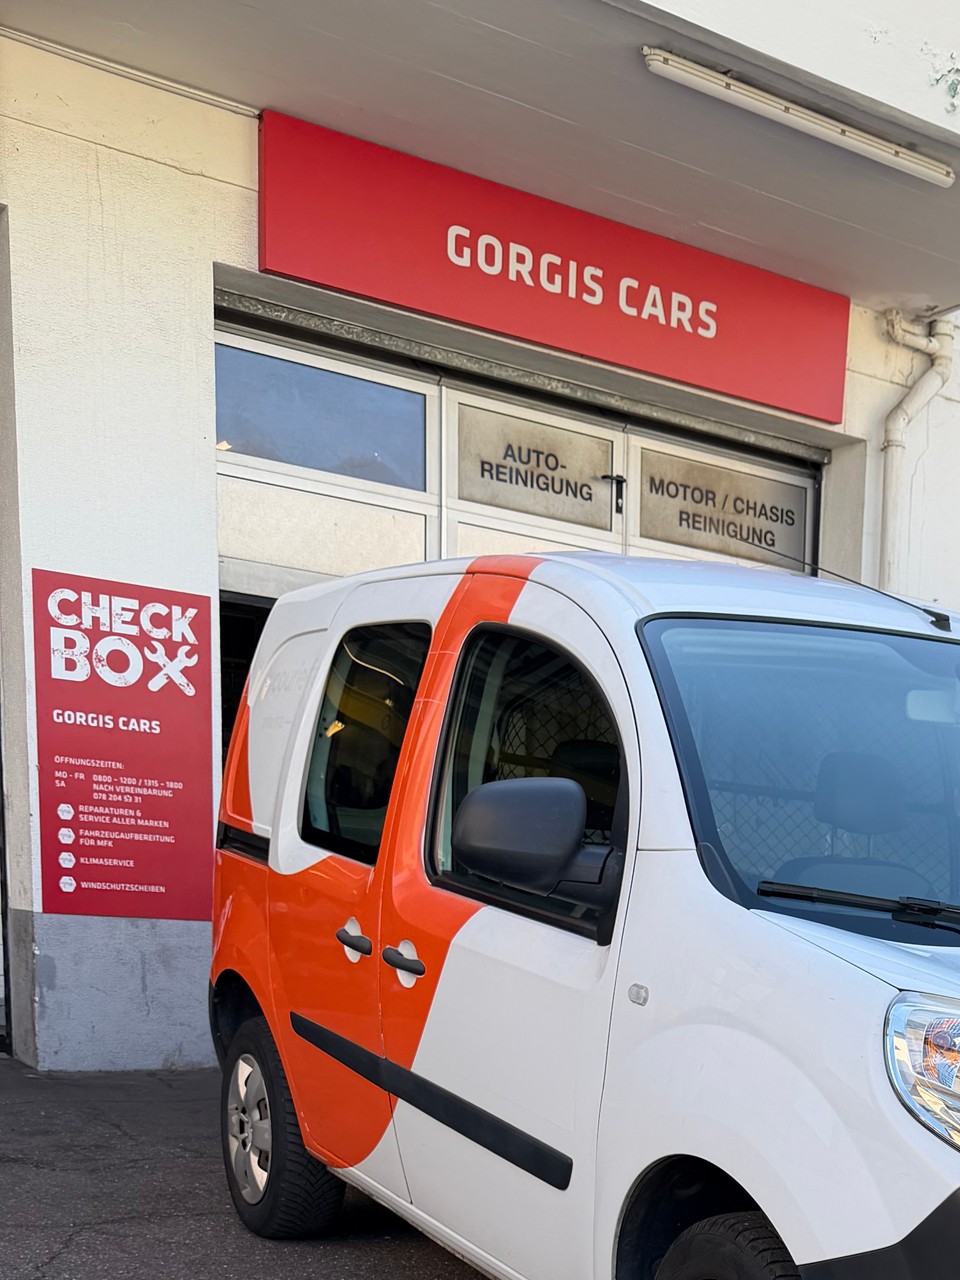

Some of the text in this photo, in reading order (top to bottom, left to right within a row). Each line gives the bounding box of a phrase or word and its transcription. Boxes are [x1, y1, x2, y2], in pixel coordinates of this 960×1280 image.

[447, 224, 718, 339] GORGIS CARS
[502, 443, 567, 473] AUTO-
[480, 460, 593, 503] REINIGUNG
[649, 476, 796, 527] MOTOR / CHASIS
[678, 510, 776, 549] REINIGUNG
[48, 588, 198, 644] CHECK
[53, 709, 160, 733] GORGIS CARS
[54, 755, 125, 769] ÖFFNUNGSZEITEN:
[55, 770, 67, 778] MO
[75, 772, 85, 780] FR
[93, 774, 112, 782] 0800
[120, 776, 137, 785] 1200
[166, 781, 183, 790] 1800
[93, 783, 114, 792] NACH
[116, 786, 173, 797] VEREINBARUNG
[93, 792, 107, 800] 078
[79, 804, 135, 816] REPARATUREN
[79, 814, 170, 829] SERVICE ALLER MARKEN
[79, 829, 176, 844] FAHRZEUGAUFBEREITUNG
[80, 838, 114, 847] FÜR MFK
[80, 857, 135, 868] KLIMASERVICE
[80, 881, 166, 893] WINDSCHUTZSCHEIBEN
